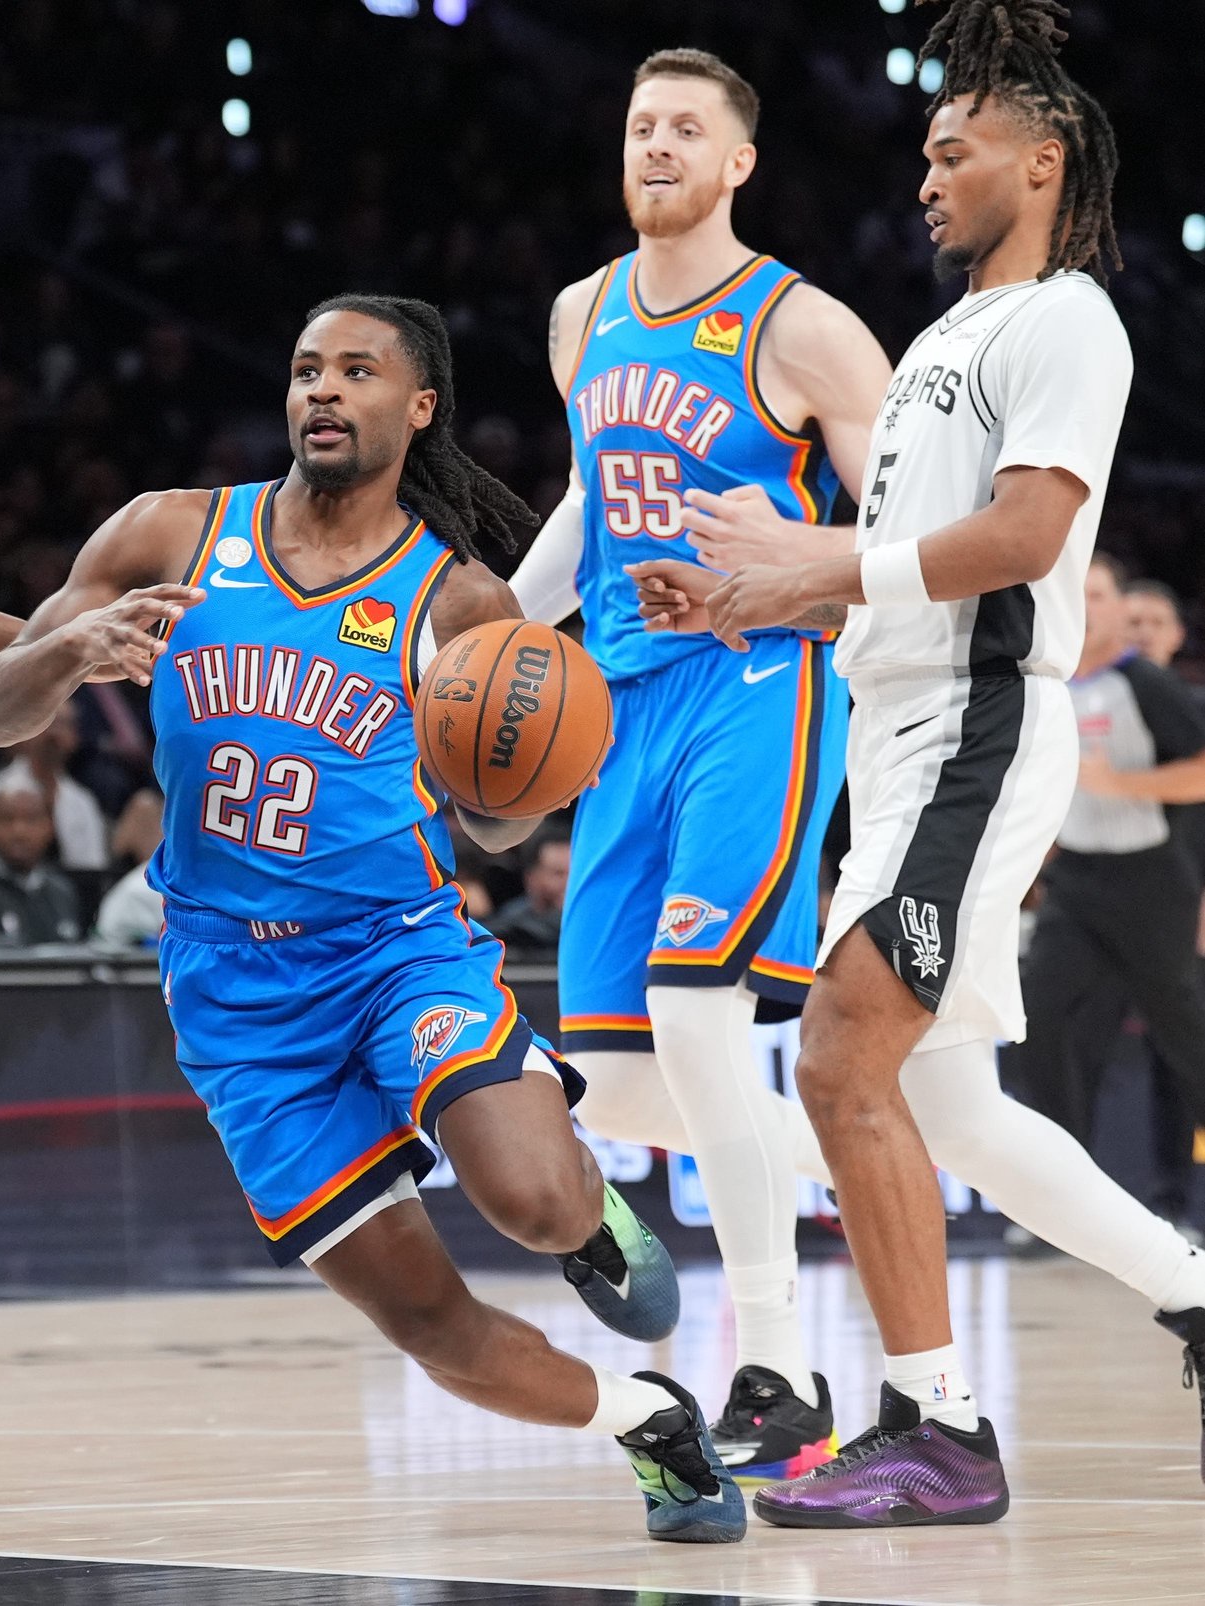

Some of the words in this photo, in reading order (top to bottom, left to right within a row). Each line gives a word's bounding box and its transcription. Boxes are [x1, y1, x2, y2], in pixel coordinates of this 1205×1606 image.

[575, 363, 735, 461] THUNDER
[597, 451, 686, 540] 55
[865, 450, 899, 532] 5
[174, 644, 398, 760] THUNDER
[488, 645, 553, 770] Wilson
[201, 742, 318, 856] 22
[659, 905, 699, 935] OKC
[416, 1012, 453, 1062] OKC
